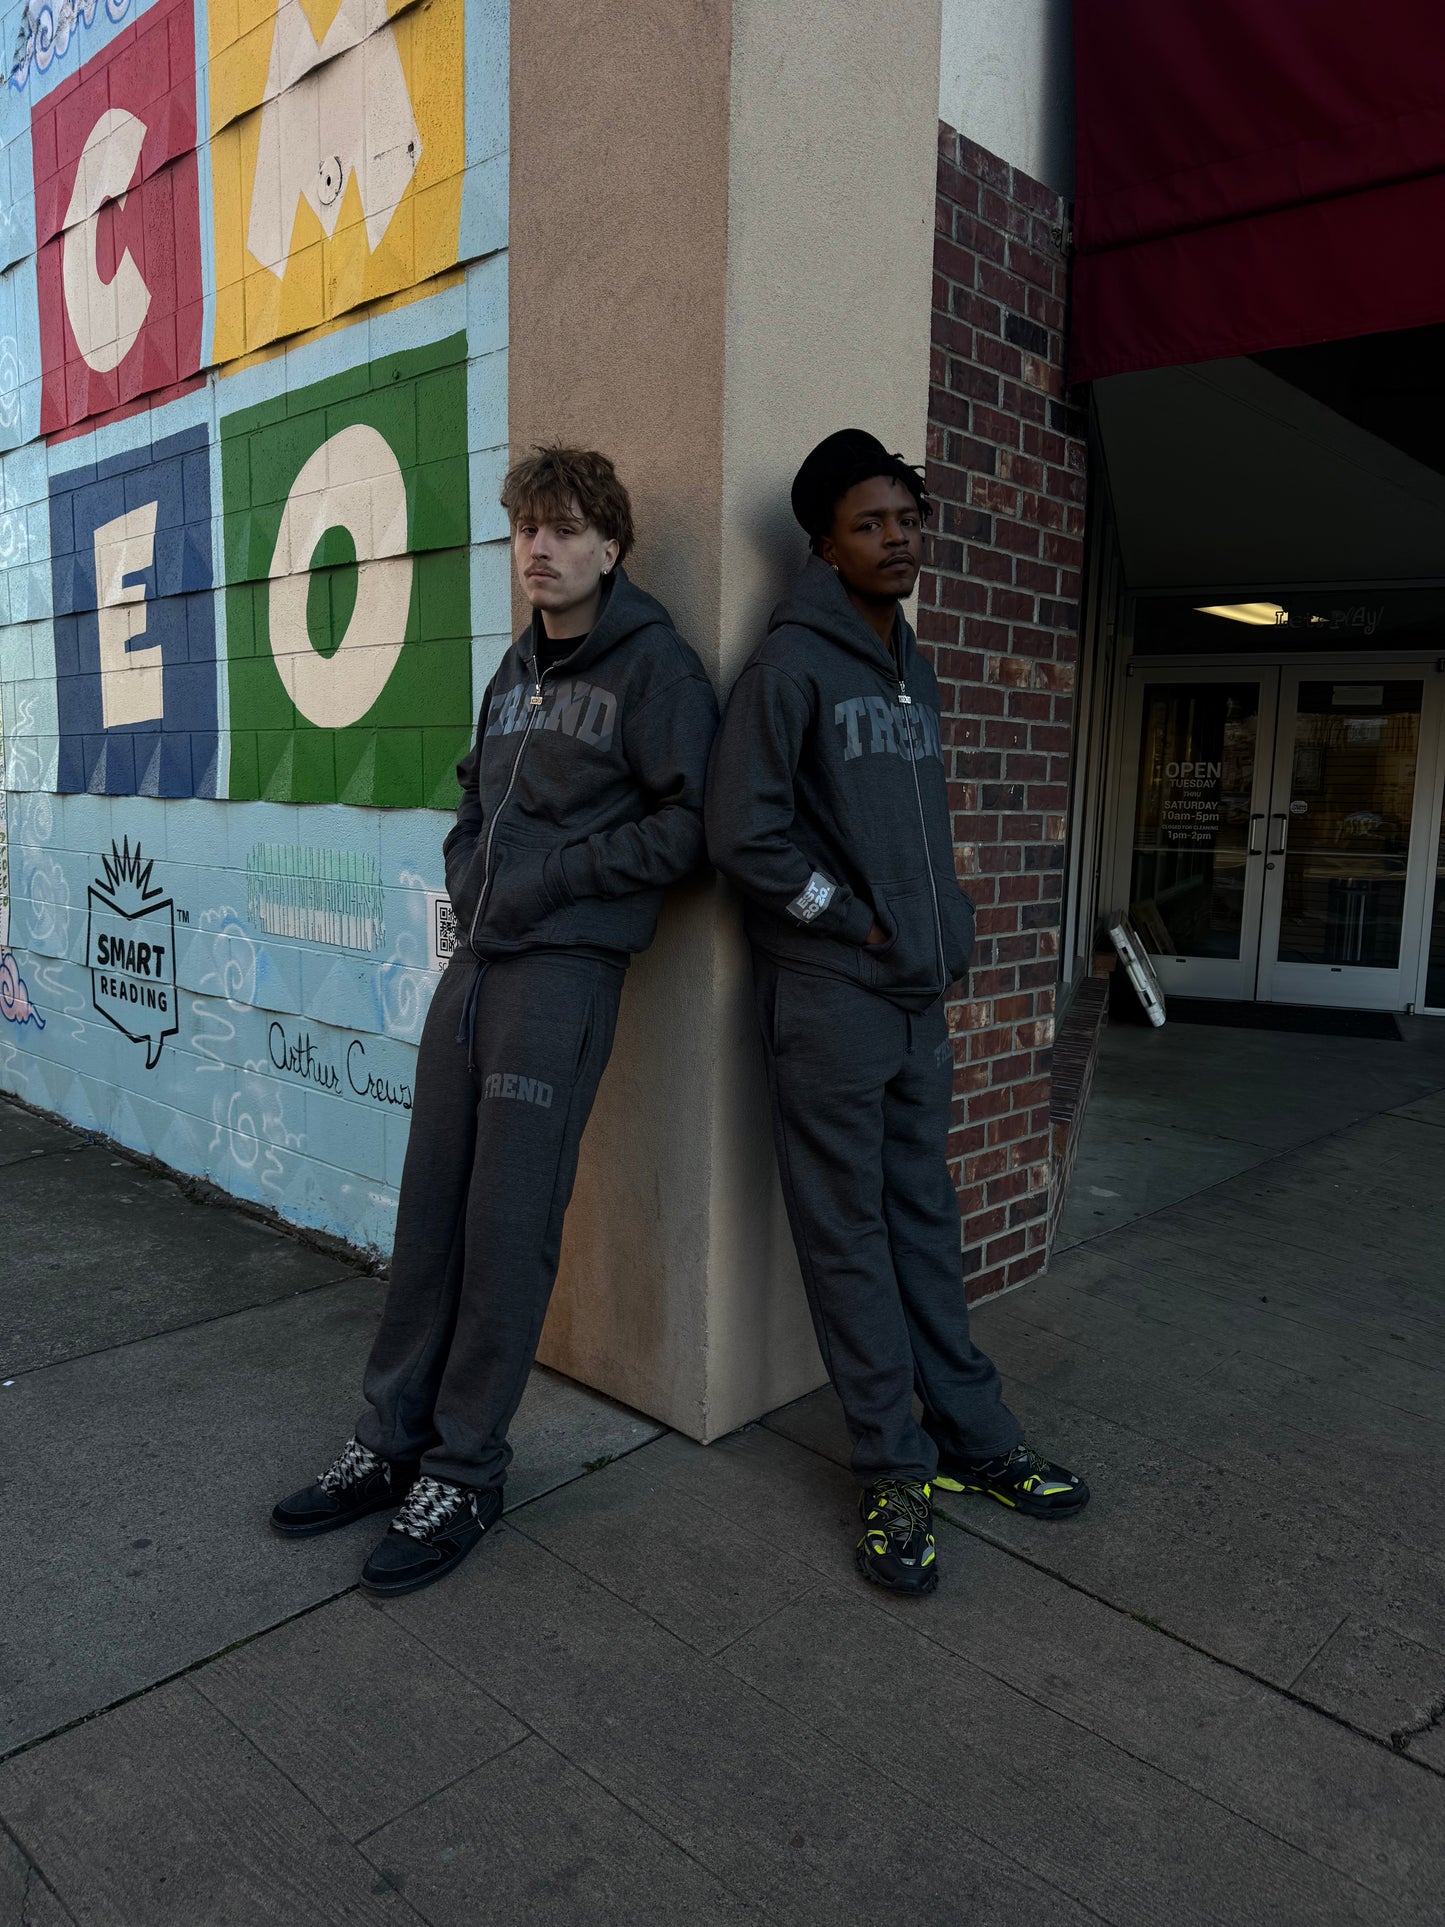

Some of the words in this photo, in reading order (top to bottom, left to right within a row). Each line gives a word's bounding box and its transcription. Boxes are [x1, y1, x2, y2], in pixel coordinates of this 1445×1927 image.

[62, 108, 151, 373] C
[268, 423, 413, 728] O
[94, 500, 164, 729] E
[834, 696, 944, 766] TREN
[1165, 761, 1221, 778] OPEN
[1170, 779, 1216, 788] TUESDAY
[1164, 800, 1218, 810] SATURDAY
[1161, 811, 1220, 823] 10am-5pm
[1168, 830, 1212, 841] 1pm-2pm
[796, 881, 819, 909] EST
[176, 909, 190, 923] TM
[97, 933, 165, 978] SMART
[439, 962, 448, 972] SC
[100, 975, 167, 1012] READING
